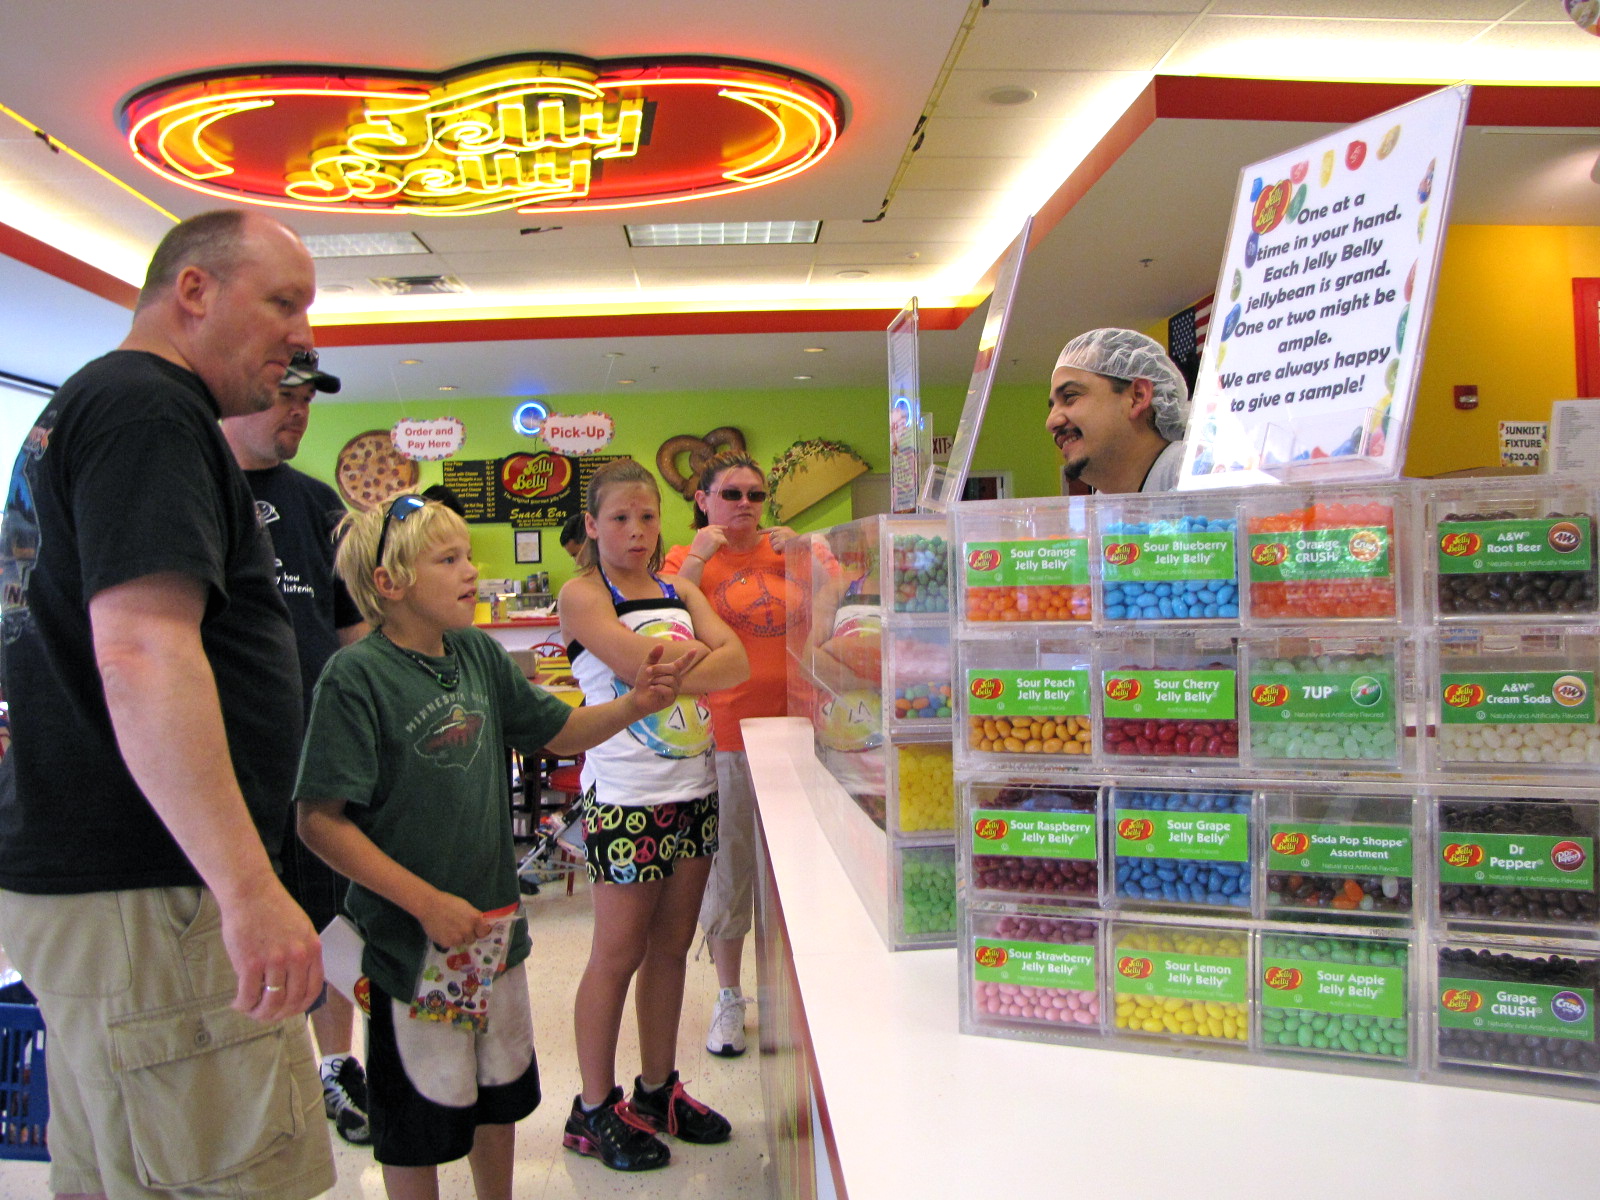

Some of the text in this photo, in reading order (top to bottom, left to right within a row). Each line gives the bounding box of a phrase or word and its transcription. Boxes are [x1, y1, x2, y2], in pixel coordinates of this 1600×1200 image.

[347, 86, 643, 160] Jelly
[285, 154, 591, 204] Belly
[1298, 192, 1365, 224] One at a
[1257, 205, 1402, 262] time in your hand.
[1263, 238, 1383, 283] Each Jelly Belly
[1246, 260, 1391, 312] jellybean is grand.
[1235, 288, 1396, 338] One or two might be
[1278, 332, 1332, 355] ample.
[1221, 346, 1390, 389] We are always happy
[1231, 375, 1365, 412] to give a sample!
[405, 427, 454, 437] Order and
[551, 426, 605, 440] Pick-Up
[1505, 426, 1540, 435] SUNKIST
[408, 440, 451, 450] Pay Here
[932, 437, 948, 454] XIT
[1505, 439, 1541, 448] FIXTURE
[1509, 453, 1539, 461] $20.00
[523, 457, 554, 477] Jelly
[512, 474, 547, 492] Belly
[509, 506, 568, 520] Snack Bar
[1454, 535, 1471, 545] Jelly
[1115, 545, 1131, 554] Jelly
[1143, 541, 1228, 552] Sour Blueberry
[1296, 540, 1339, 551] Orange
[1447, 543, 1467, 552] Belly
[1487, 544, 1542, 553] Root Beer
[977, 552, 993, 561] Jelly
[1010, 547, 1077, 559] Sour Orange
[1110, 552, 1128, 561] Belly
[1296, 552, 1337, 563] CRUSH
[973, 559, 990, 568] Belly
[1154, 553, 1212, 565] Jelly Belly
[1015, 560, 1068, 571] Jelly Belly
[980, 680, 995, 689] Jelly
[1016, 678, 1075, 688] Sour Peach
[1117, 681, 1133, 690] Jelly
[1153, 679, 1219, 691] Sour Cherry
[976, 687, 993, 696] Belly
[1017, 690, 1071, 701] Jelly Belly
[1111, 688, 1130, 697] Belly
[1263, 686, 1279, 695] Jelly
[1302, 686, 1333, 698] 7UP
[1456, 687, 1473, 695] Jelly
[1156, 691, 1212, 703] Jelly Belly
[1257, 694, 1276, 702] Belly
[1450, 694, 1470, 703] Belly
[1486, 695, 1552, 703] Cream Soda
[984, 820, 1000, 830] Jelly
[1010, 820, 1091, 833] Sour Raspberry
[1128, 820, 1145, 830] Jelly
[1167, 820, 1231, 832] Sour Grape
[979, 827, 997, 837] Belly
[1123, 828, 1142, 838] Belly
[1022, 832, 1074, 845] Jelly Belly
[1168, 832, 1225, 845] Jelly Belly
[1283, 834, 1299, 843] Jelly
[1311, 835, 1403, 848] Soda Pop Shoppe
[1277, 842, 1296, 850] Belly
[1456, 846, 1472, 855] Jelly
[1509, 844, 1525, 854] Dr
[1330, 849, 1389, 859] Assortment
[1449, 854, 1469, 862] Belly
[1490, 857, 1537, 870] Pepper
[984, 949, 1000, 959] Jelly
[1008, 949, 1092, 964] Sour Strawberry
[979, 956, 997, 965] Belly
[1128, 959, 1144, 969] Jelly
[1022, 962, 1074, 976] Jelly Belly
[1123, 966, 1141, 976] Belly
[1165, 960, 1232, 975] Sour Lemon
[1276, 971, 1292, 979] Jelly
[1317, 971, 1385, 986] Sour Apple
[1168, 973, 1224, 988] Jelly Belly
[1270, 978, 1289, 986] Belly
[1318, 984, 1378, 1000] Jelly Belly
[1454, 992, 1471, 1001] Jelly
[1496, 991, 1537, 1005] Grape
[1447, 1000, 1467, 1008] Belly
[1556, 998, 1581, 1014] Crush
[1491, 1004, 1536, 1017] CRUSH
